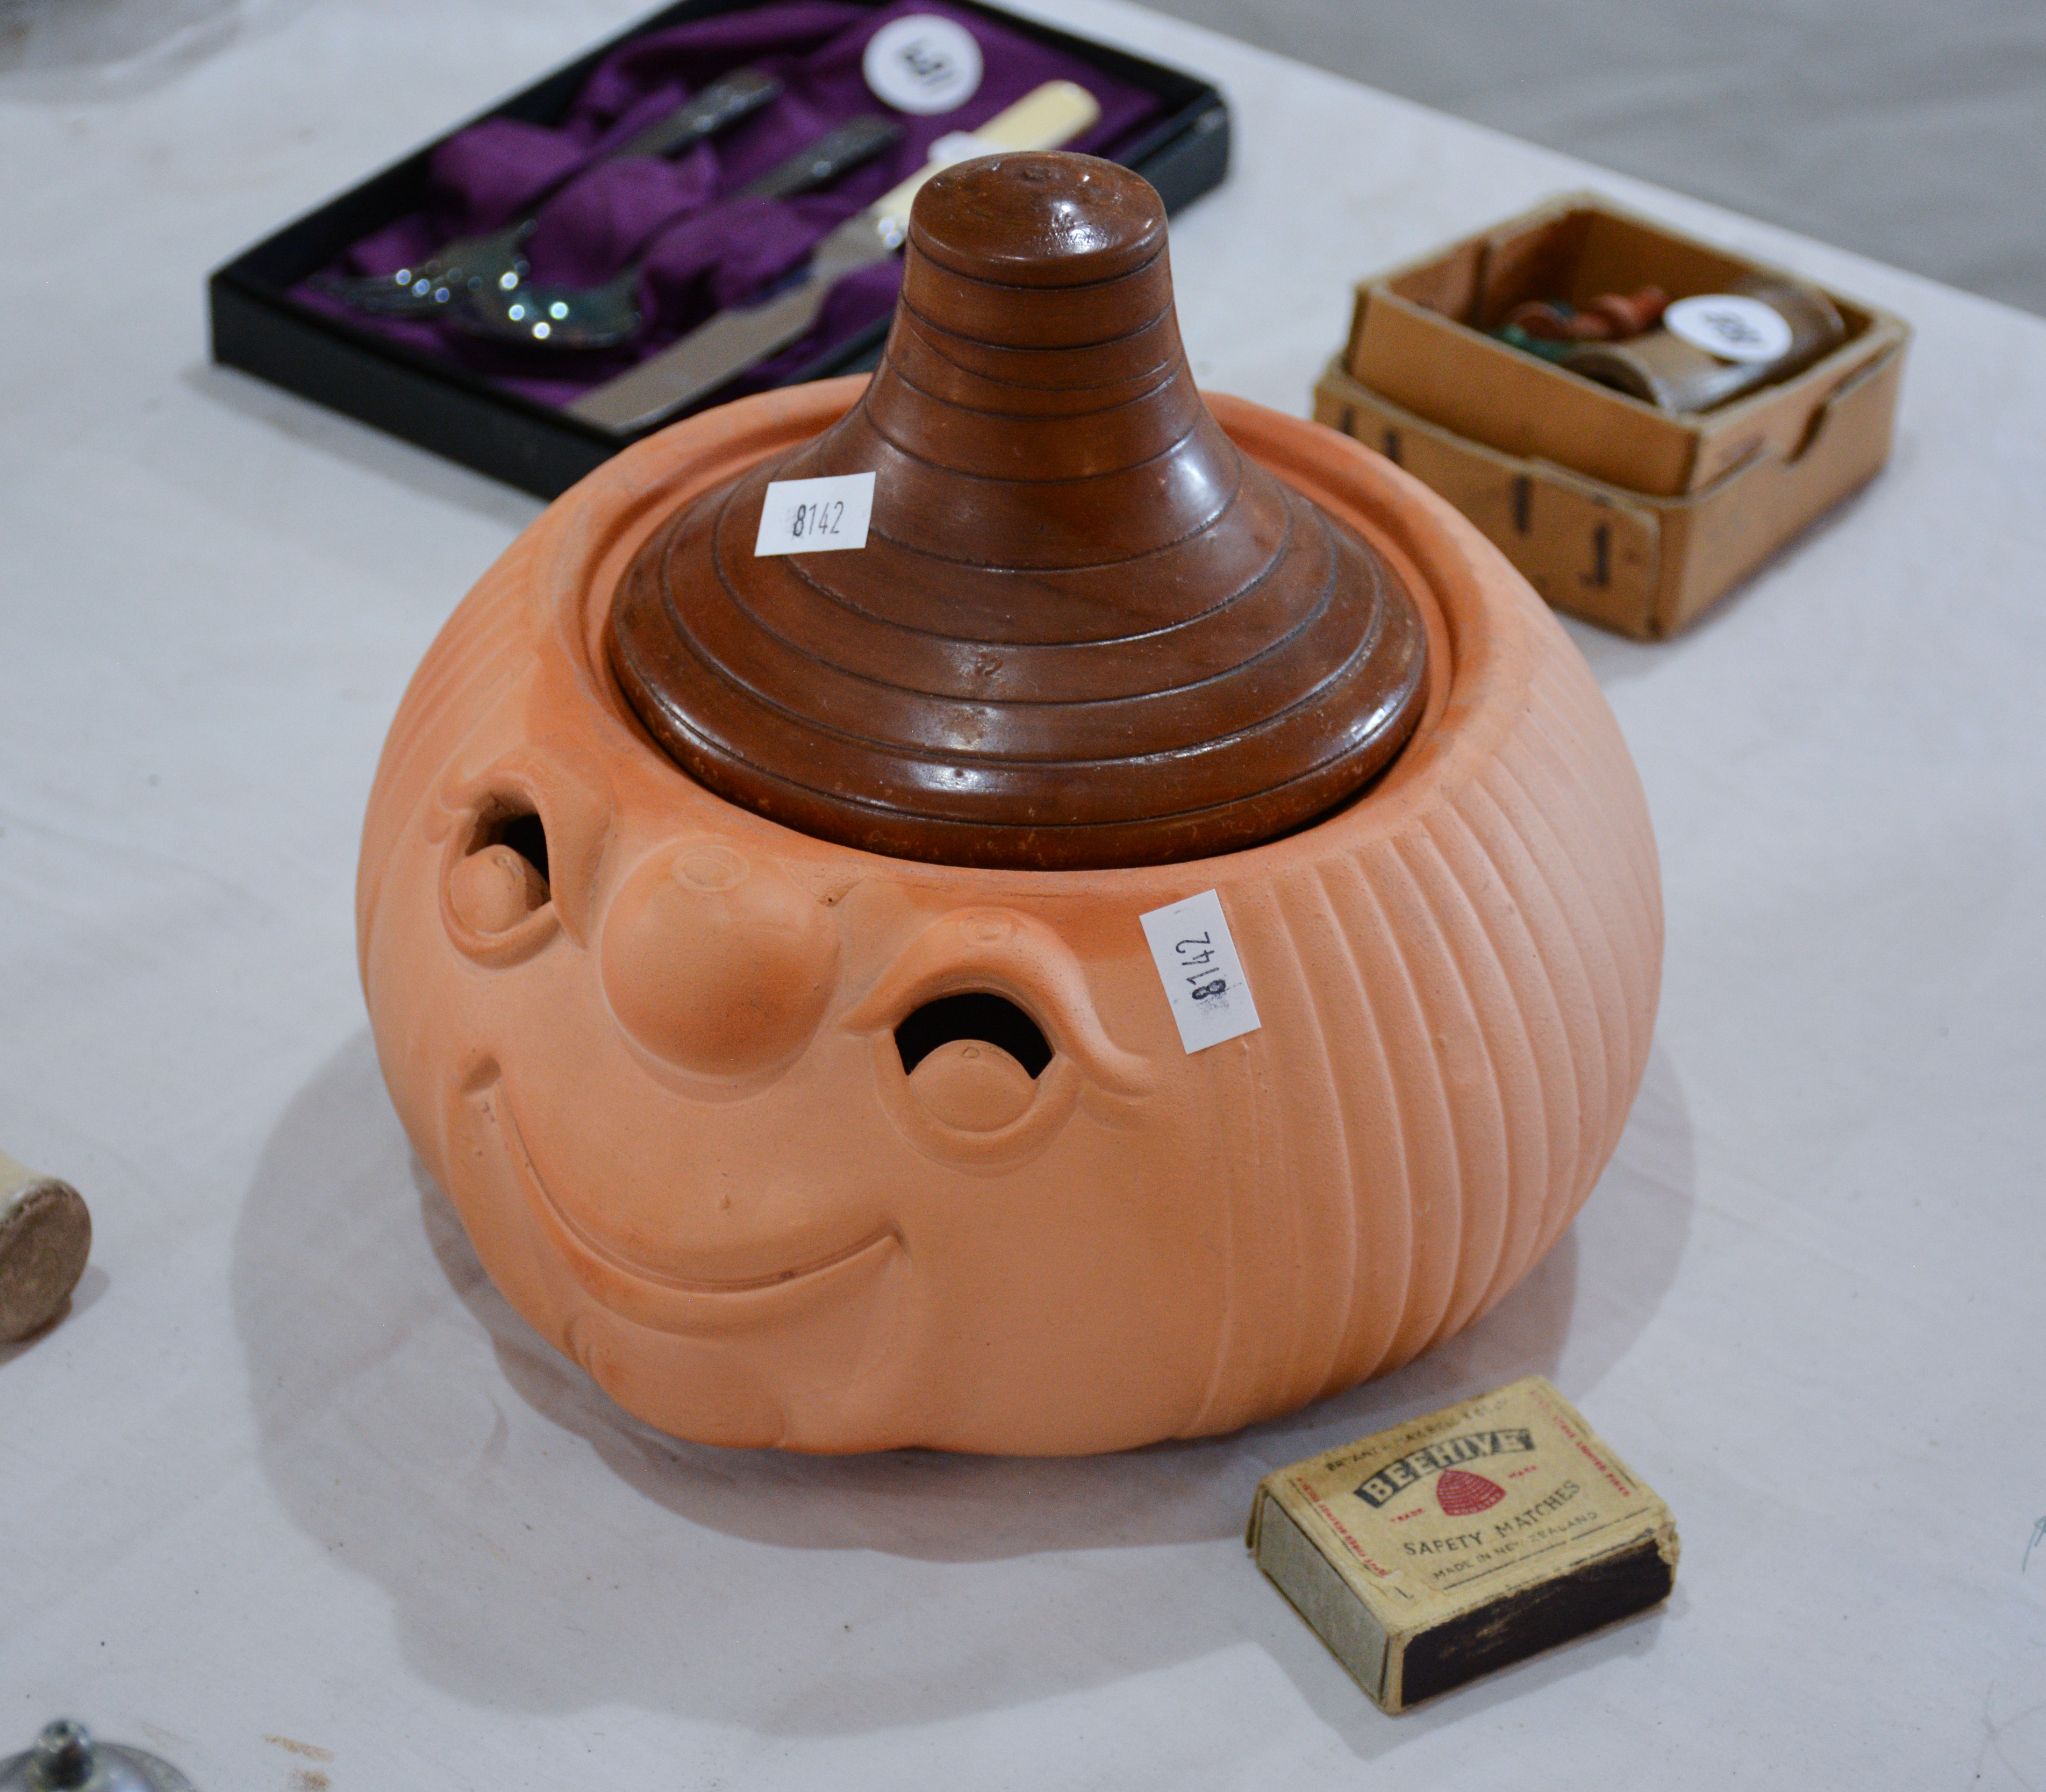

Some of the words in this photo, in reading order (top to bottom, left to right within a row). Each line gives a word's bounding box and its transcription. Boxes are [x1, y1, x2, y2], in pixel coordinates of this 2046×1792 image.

[793, 500, 844, 537] 8142
[1175, 931, 1227, 1000] 8142
[1359, 1431, 1525, 1505] BEEHIVE
[1403, 1531, 1483, 1556] SAFETY
[1494, 1479, 1581, 1538] MATCHES
[1432, 1561, 1474, 1580] MADE
[1476, 1552, 1492, 1562] IN
[1528, 1511, 1598, 1542] ZEALAND
